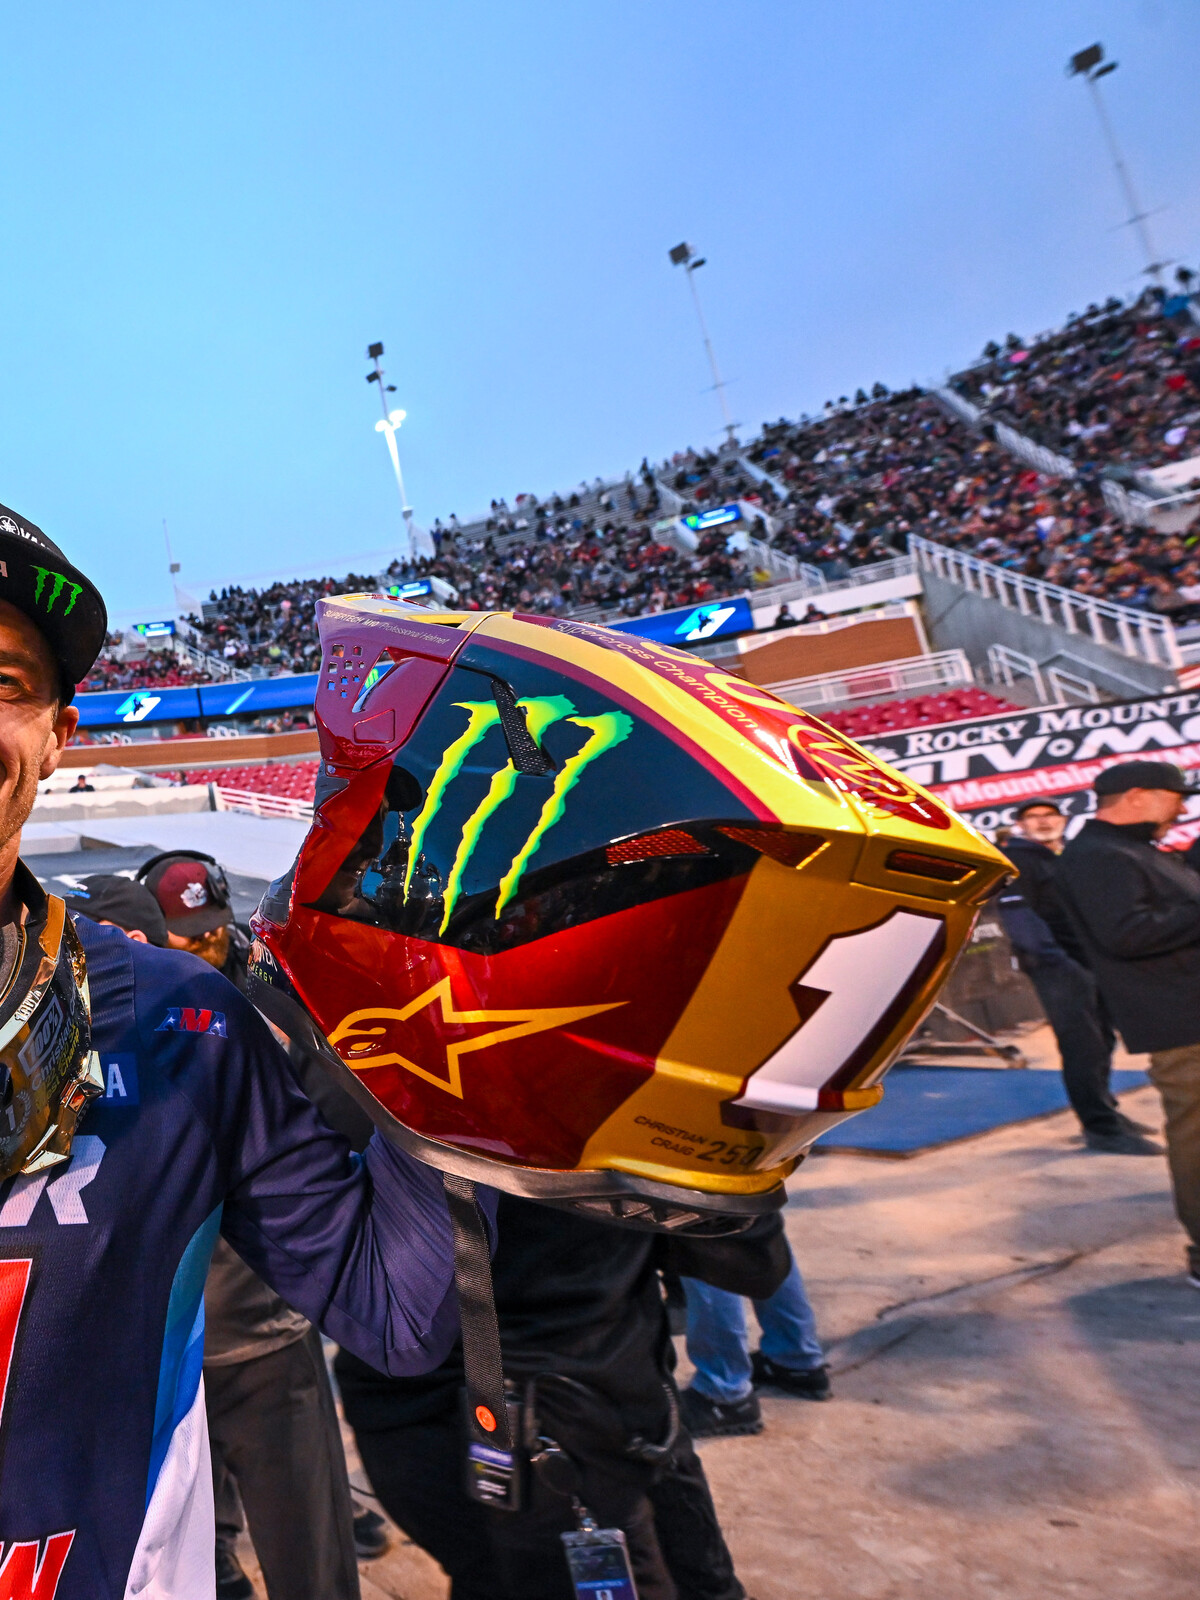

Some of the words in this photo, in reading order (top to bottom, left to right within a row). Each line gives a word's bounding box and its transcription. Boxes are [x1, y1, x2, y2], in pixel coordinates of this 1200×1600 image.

[323, 609, 362, 624] SUPERTECH
[556, 621, 655, 660] Supercross
[654, 659, 759, 729] Champion
[904, 719, 1028, 756] ROCKY
[154, 1006, 229, 1039] AMA
[730, 911, 943, 1112] 1
[634, 1115, 708, 1144] CHRISTIAN
[650, 1136, 695, 1156] CRAIG
